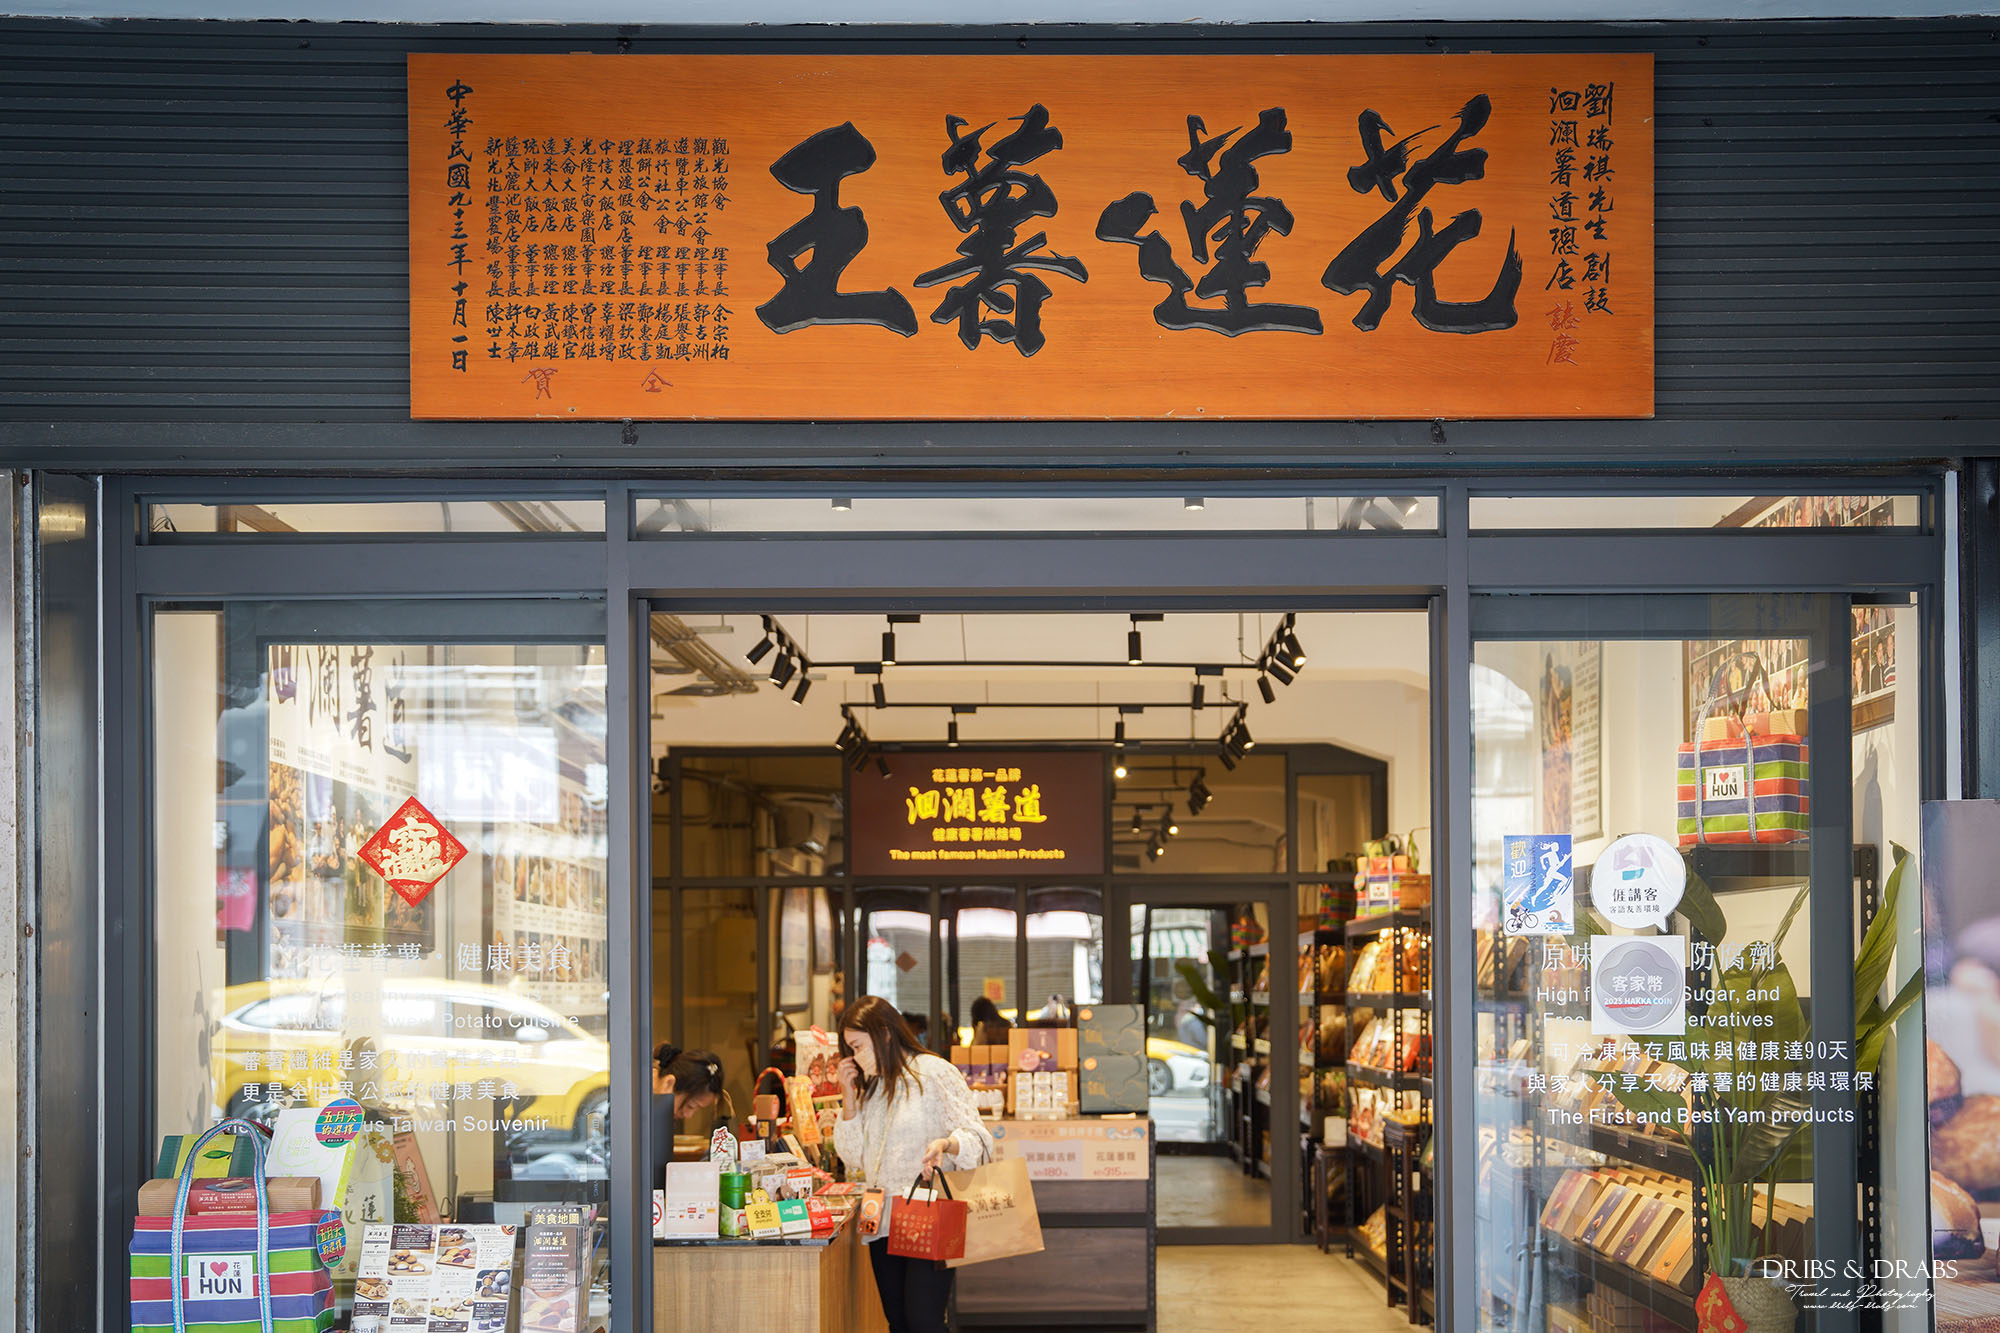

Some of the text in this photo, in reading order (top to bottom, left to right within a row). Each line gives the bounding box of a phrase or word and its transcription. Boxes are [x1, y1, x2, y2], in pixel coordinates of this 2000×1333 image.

[1582, 81, 1615, 241] 劉瑞祺先生
[711, 137, 731, 210] 觀光協會
[503, 136, 522, 243] 藍天麗池飯店
[521, 138, 541, 233] 統帥大飯店
[579, 137, 598, 244] 光隆宇宙樂園
[597, 139, 616, 231] 中信大飯店
[616, 139, 636, 243] 理想渡假飯店
[653, 138, 674, 234] 旅行社公會
[673, 137, 693, 236] 遊覽車公會
[691, 137, 712, 245] 觀光旅館公會
[1545, 86, 1581, 291] 洄瀾薯道總店
[443, 79, 473, 373] 中華民國九十三年十月一日
[521, 367, 558, 400] 賀
[1712, 783, 1738, 797] HUN
[905, 784, 1048, 824] 洄瀾薯道
[889, 849, 910, 860] The
[911, 850, 937, 860] most
[938, 849, 976, 860] famous
[1018, 849, 1065, 860] Products
[1511, 840, 1531, 879] 歡迎
[1609, 904, 1660, 914] 客語友善環境
[1612, 975, 1664, 992] 客家幣
[1537, 987, 1579, 1006] High
[1745, 986, 1780, 1001] and
[1604, 996, 1673, 1005] 2025 HAKKA COIN
[444, 1013, 503, 1029] Potato
[508, 1013, 579, 1029] Cuisine
[1543, 1012, 1774, 1028] Free ervatives
[322, 1109, 358, 1124] 五月天
[390, 1116, 457, 1132] Taiwan
[463, 1115, 549, 1132] Souvenir
[1548, 1107, 1855, 1126] The First and Best Yam products
[321, 1123, 354, 1137] 的選擇
[535, 1213, 579, 1225] 美食地圖
[319, 1223, 344, 1244] 五月天
[321, 1239, 343, 1256] 的選擇
[200, 1262, 205, 1277] I
[200, 1278, 242, 1295] HUN
